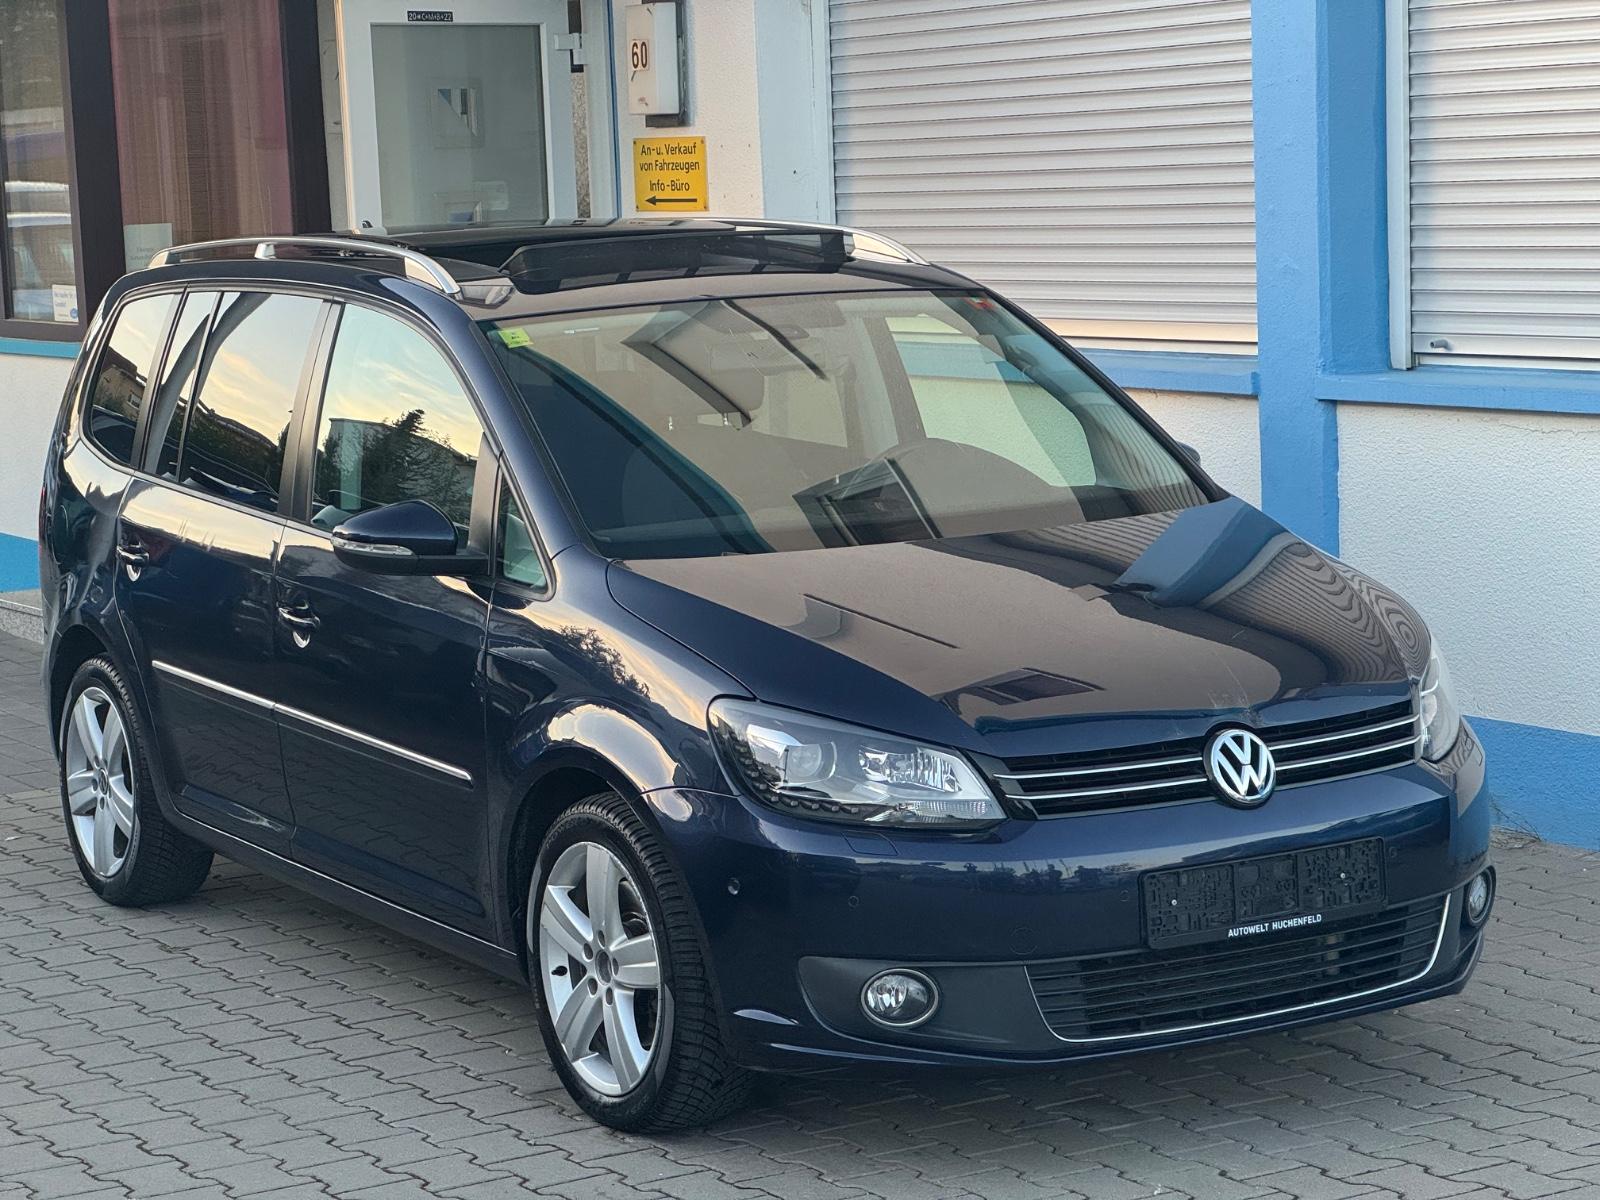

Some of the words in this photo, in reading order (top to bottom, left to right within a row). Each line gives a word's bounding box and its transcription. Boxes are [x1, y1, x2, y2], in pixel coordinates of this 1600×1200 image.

[632, 41, 648, 68] 60
[664, 142, 697, 155] Verkauf
[639, 162, 654, 171] von
[655, 159, 700, 173] Fahrzeugen
[1209, 728, 1276, 803] VW
[1227, 923, 1269, 937] AUTOWELT
[1272, 914, 1322, 929] HUCHENFELD
